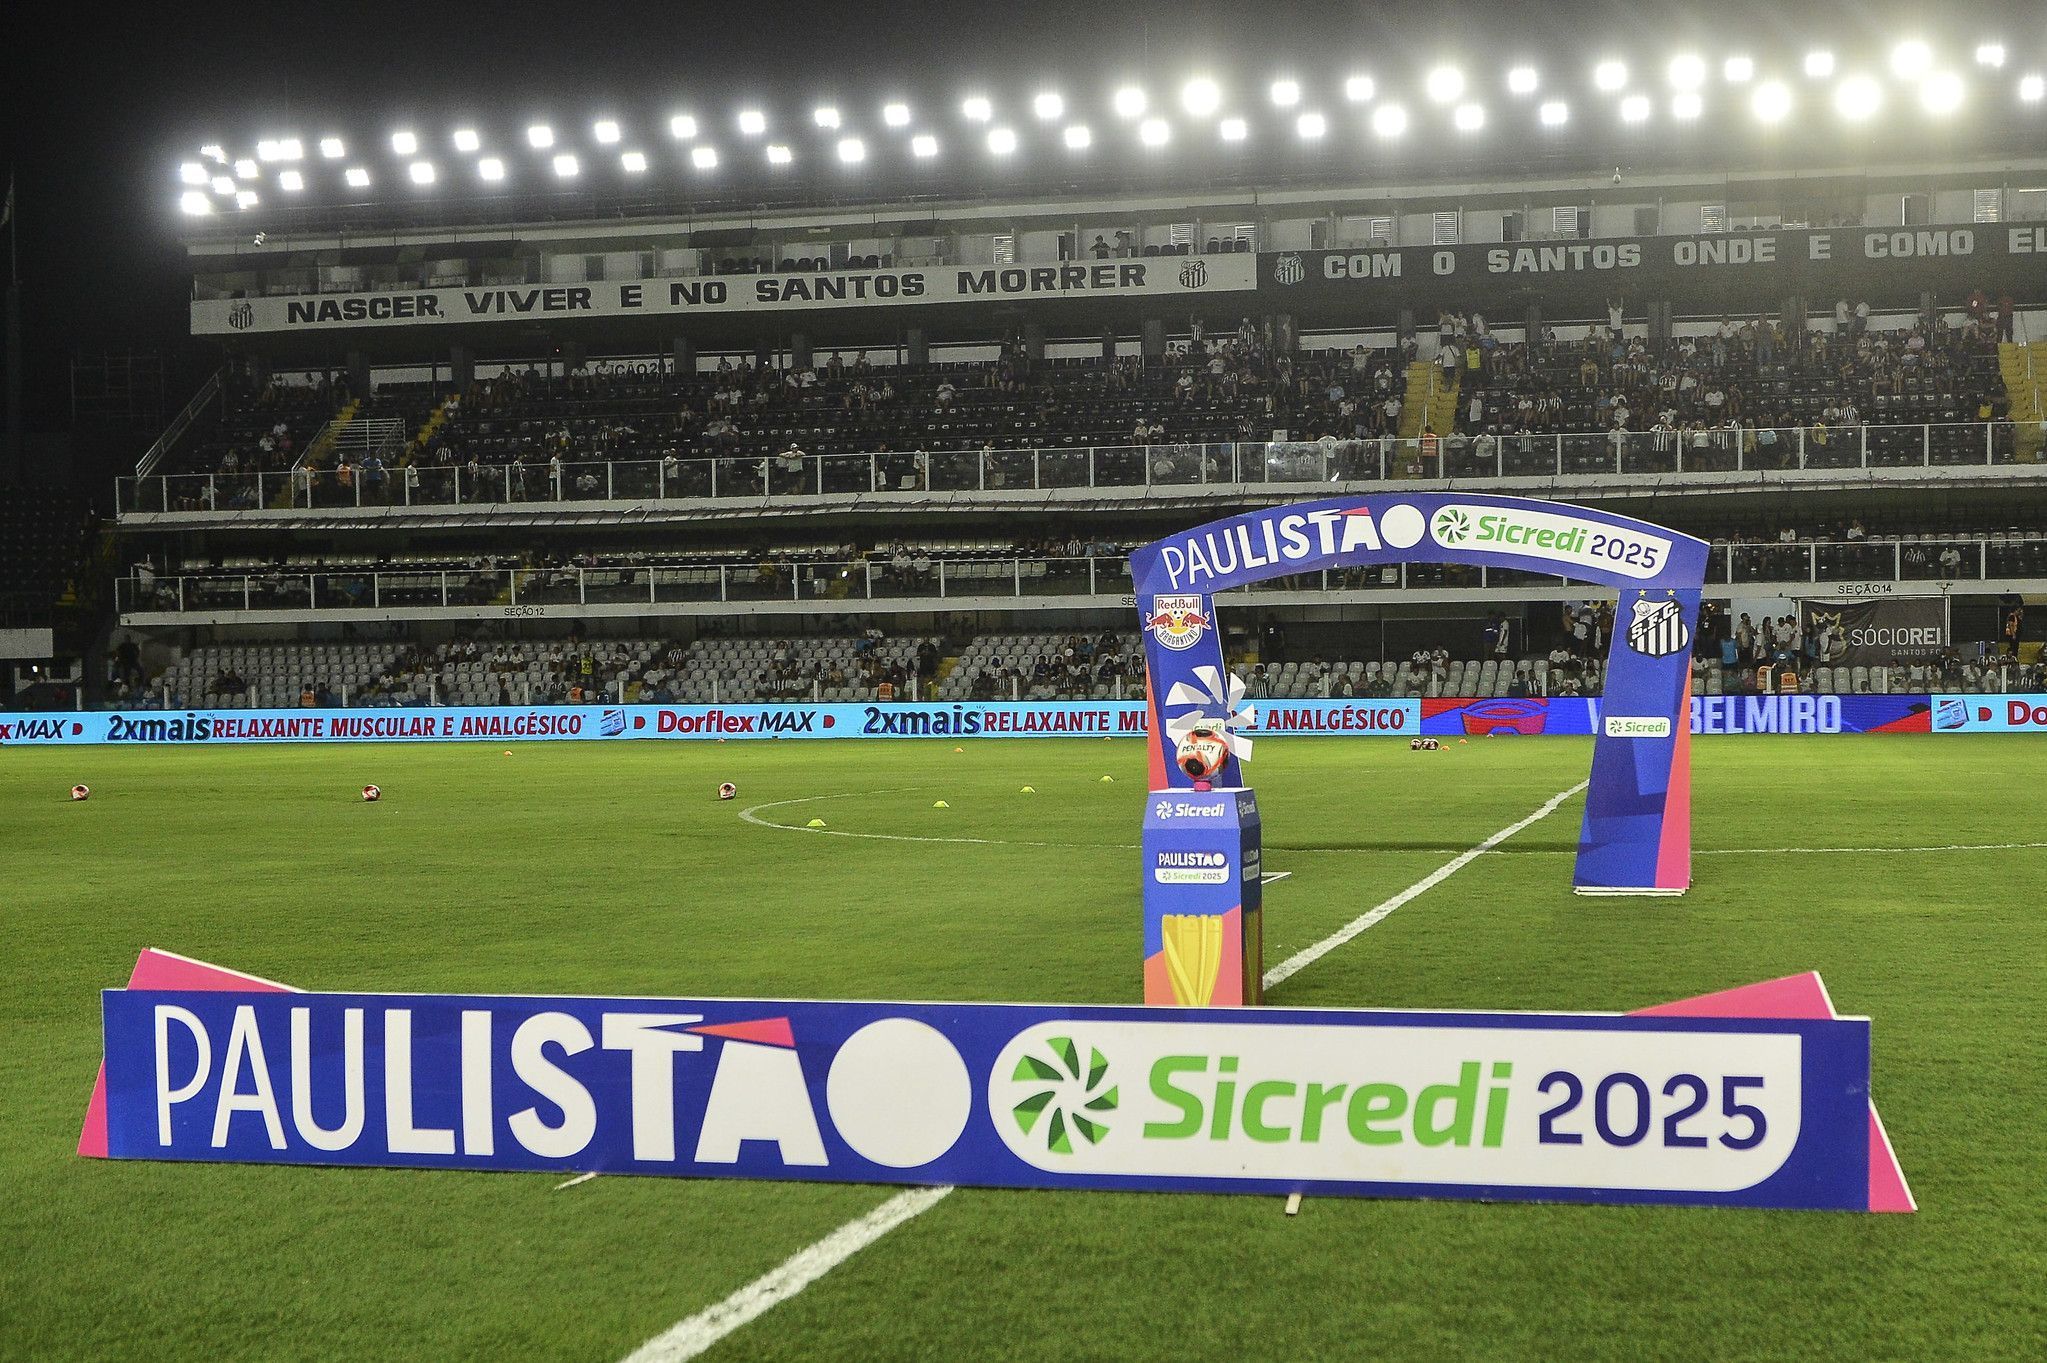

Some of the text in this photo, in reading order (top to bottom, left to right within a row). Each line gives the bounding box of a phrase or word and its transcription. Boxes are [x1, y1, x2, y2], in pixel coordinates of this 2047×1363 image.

[1323, 253, 1402, 279] COM
[1432, 251, 1456, 276] O
[1487, 244, 1641, 273] SANTOS
[1673, 237, 1776, 266] ONDE
[1808, 235, 1831, 260] E
[1864, 229, 1974, 259] COMO
[287, 295, 445, 324] NASCER,
[464, 288, 592, 314] VIVER
[620, 284, 643, 308] E
[671, 281, 727, 306] NO
[756, 274, 925, 303] SANTOS
[957, 263, 1147, 295] MORRER
[1476, 515, 1659, 570] Sicredi 2025
[1159, 629, 1198, 646] BRAGANTINO
[1891, 648, 1927, 657] SANTOS
[212, 717, 323, 738] RELAXANTE
[330, 715, 435, 737] MUSCULAR
[442, 716, 454, 736] E
[984, 711, 1110, 732] RELAXANTE
[1625, 721, 1667, 733] Sicredi
[1174, 803, 1225, 817] Sicredi
[1171, 872, 1222, 881] Sicredi 2025
[1142, 1054, 1770, 1151] Sicredi 2025
